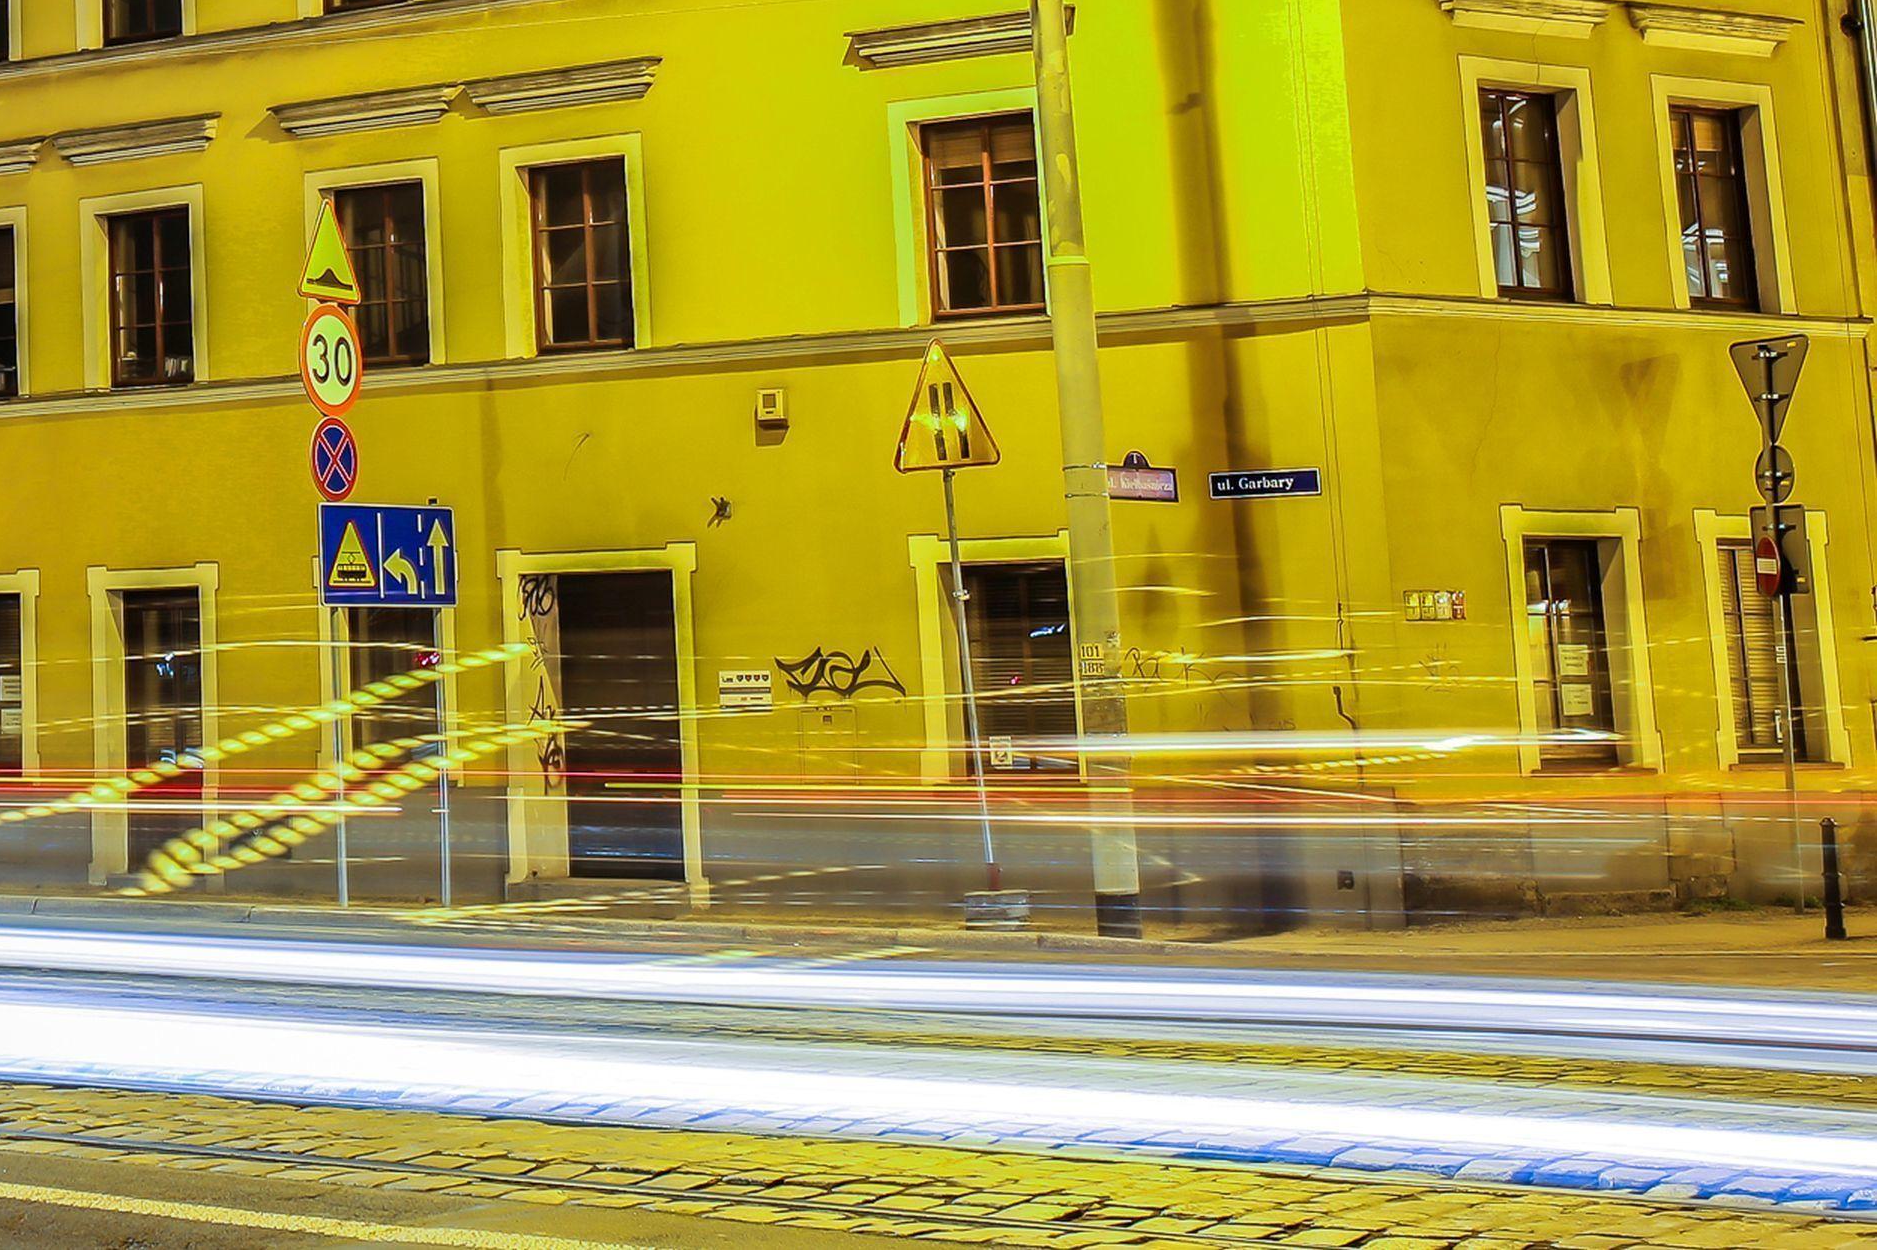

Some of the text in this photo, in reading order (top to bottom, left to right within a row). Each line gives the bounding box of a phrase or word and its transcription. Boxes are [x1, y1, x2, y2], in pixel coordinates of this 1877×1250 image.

[313, 334, 352, 386] 30
[1217, 477, 1294, 492] ul. Garbary
[1081, 645, 1100, 657] 101
